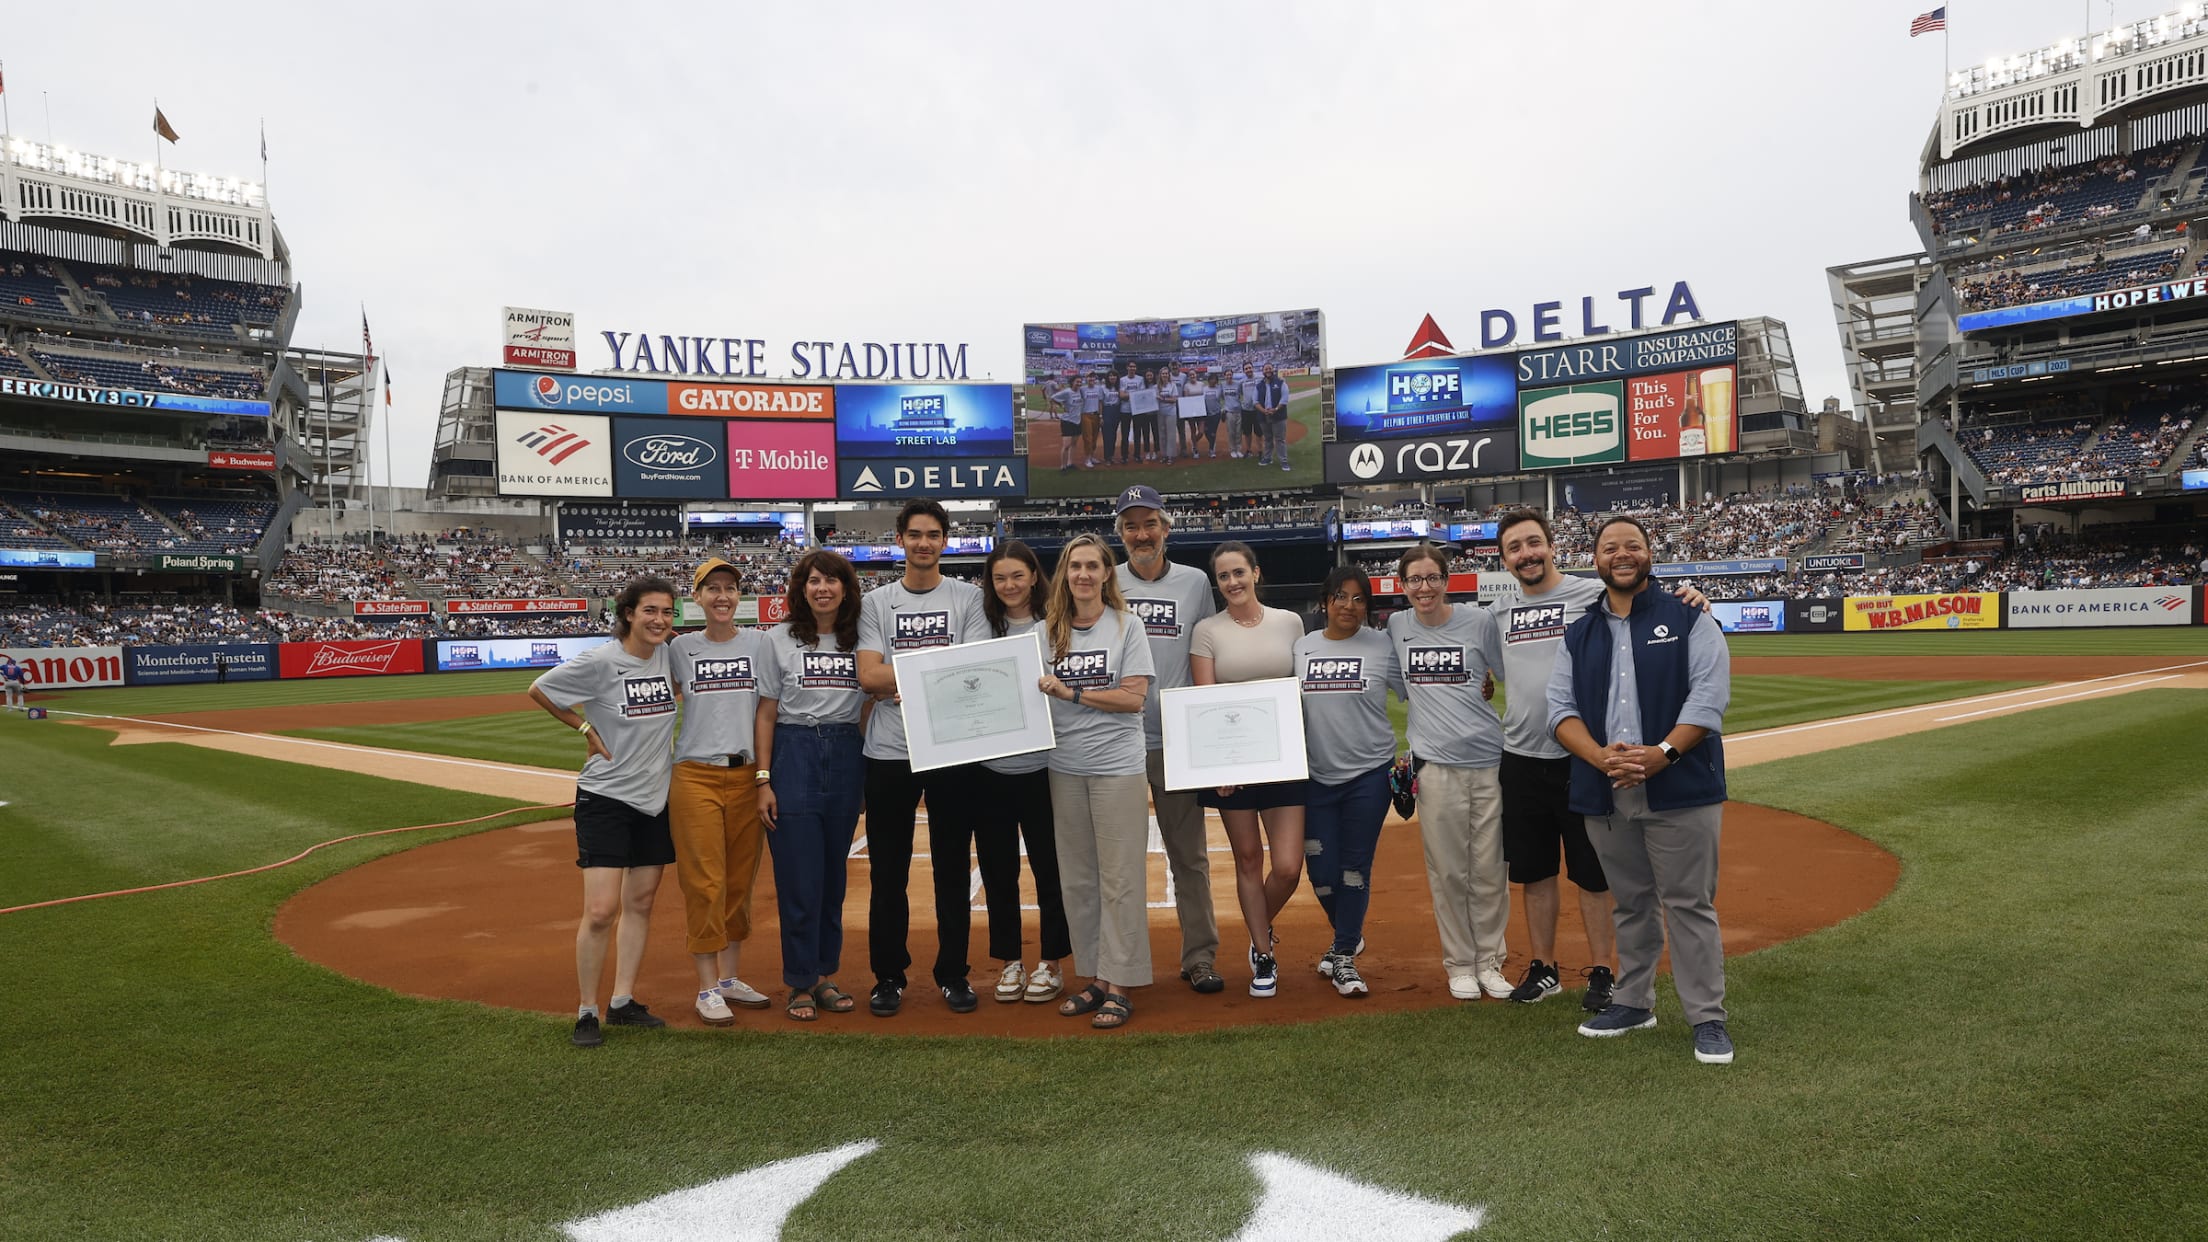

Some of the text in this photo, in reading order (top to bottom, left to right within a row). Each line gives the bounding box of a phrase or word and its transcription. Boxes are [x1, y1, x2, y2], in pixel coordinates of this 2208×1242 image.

[2096, 286, 2159, 311] HOPE
[508, 313, 571, 327] ARMITRON
[1481, 280, 1702, 348] DELTA
[1637, 327, 1736, 354] INSURANCE
[512, 349, 569, 360] ARMITRON
[600, 331, 970, 380] YANKEE STADIUM
[1637, 341, 1736, 368] COMPANIES
[1518, 346, 1624, 382] STARR
[2010, 367, 2025, 375] CUP
[2050, 361, 2067, 370] 2021
[1392, 374, 1459, 395] HOPE
[1632, 380, 1667, 396] This
[50, 386, 99, 403] JULY
[108, 392, 119, 404] 3
[144, 395, 155, 407] 7
[567, 384, 632, 406] pepsi
[679, 388, 823, 412] GATORADE
[1402, 394, 1451, 402] WEEK
[1633, 394, 1675, 411] Bud's
[903, 398, 941, 411] HOPE
[1530, 410, 1613, 441] HESS
[1633, 412, 1659, 425] For
[896, 436, 957, 445] STREET LAB
[1633, 427, 1667, 440] You.
[640, 439, 700, 465] Ford
[1397, 437, 1492, 474] razr
[230, 457, 273, 467] Budweiser
[735, 450, 828, 471] T Mobile
[501, 474, 609, 486] BANK OF AMERICA
[894, 465, 1015, 489] DELTA
[2022, 479, 2125, 498] Parts Authority
[162, 555, 234, 570] Poland Spring
[1480, 583, 1517, 592] MERRIL
[1125, 602, 1173, 617] HOPE
[1742, 607, 1768, 616] HOPE
[1856, 600, 1893, 611] WHO BUT
[2012, 602, 2149, 615] BANK OF AMERICA
[899, 615, 945, 631] HOPE
[1513, 608, 1561, 625] HOPE
[451, 646, 477, 655] HOPE
[533, 644, 558, 652] HOPE
[136, 651, 265, 666] Montefiore Einstein
[314, 651, 391, 666] Budweiser
[806, 656, 854, 671] HOPE
[1056, 654, 1105, 671] HOPE
[1411, 651, 1460, 666] HOPE
[698, 661, 748, 674] HOPE
[1310, 661, 1358, 674] HOPE
[627, 681, 668, 698] HOPE
